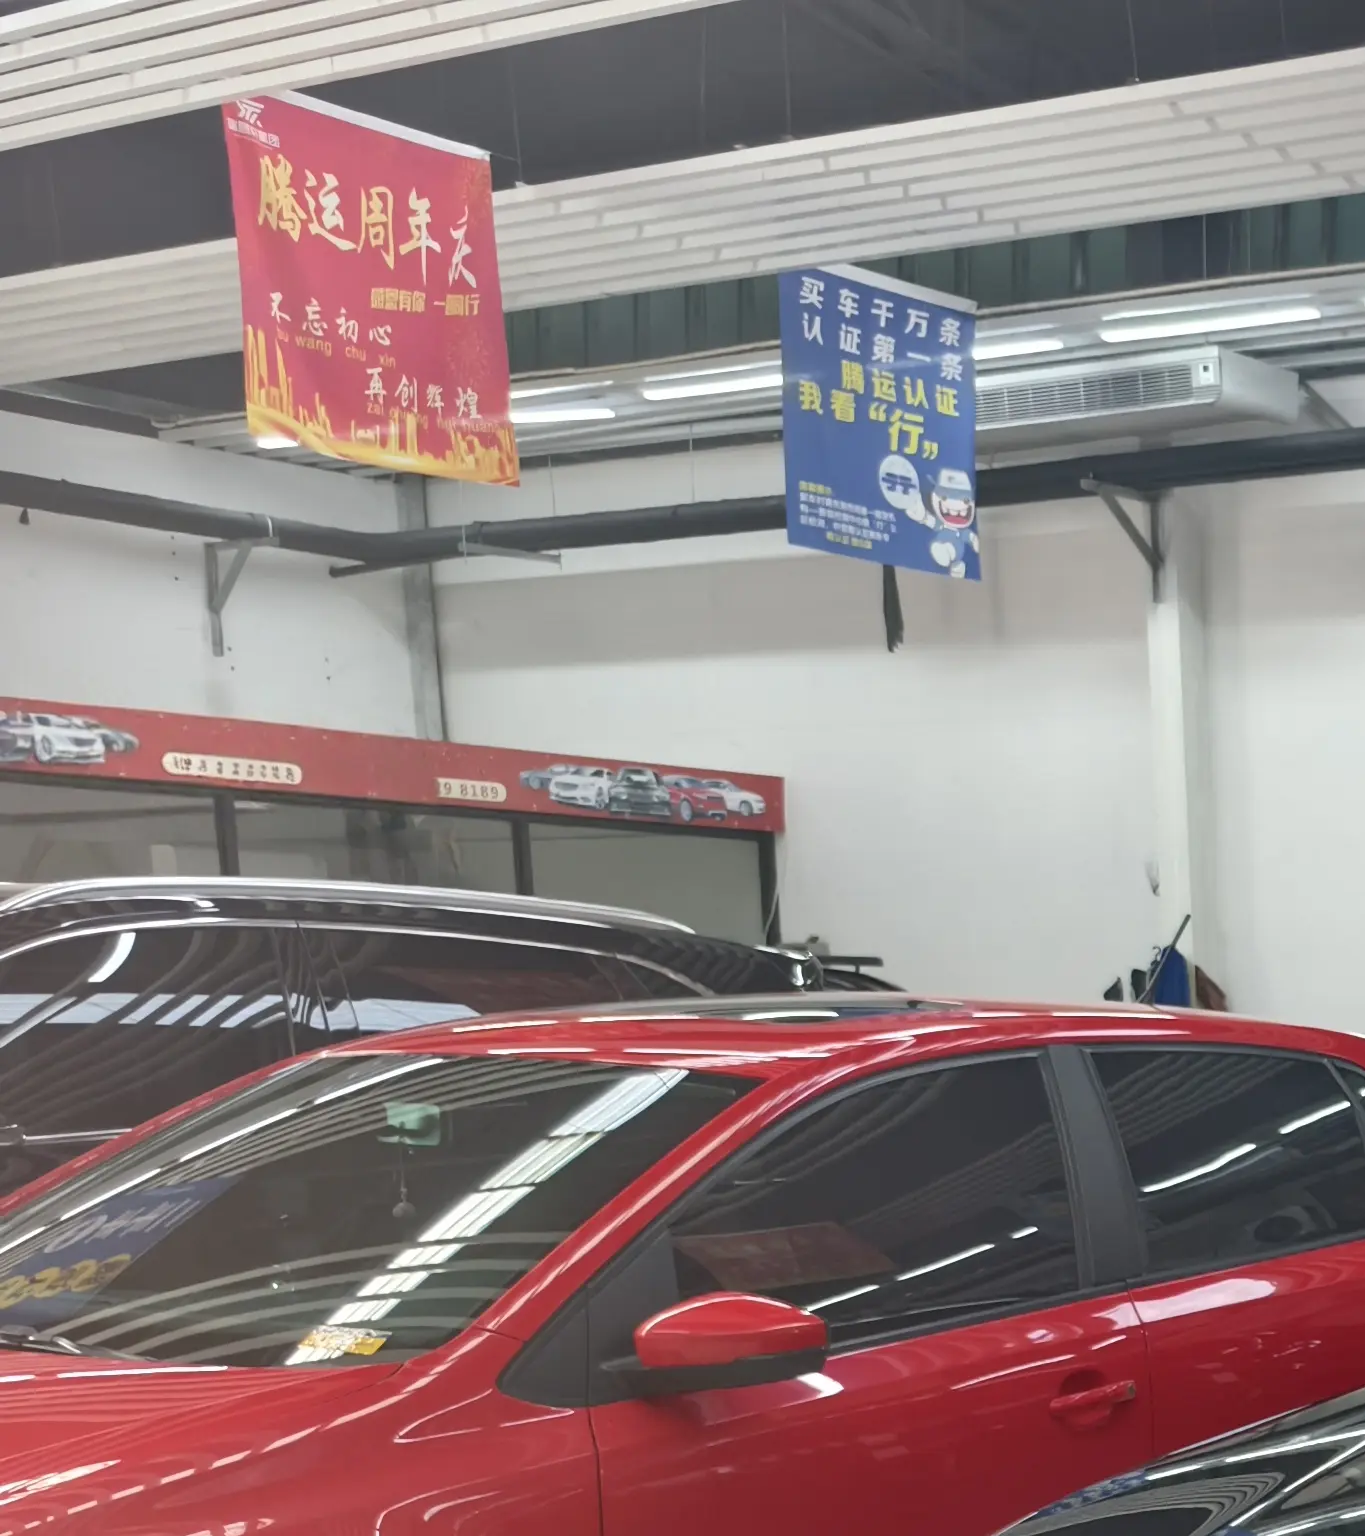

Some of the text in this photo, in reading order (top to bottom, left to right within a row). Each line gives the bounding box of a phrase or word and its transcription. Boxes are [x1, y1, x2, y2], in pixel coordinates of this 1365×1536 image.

[257, 153, 477, 289] 腾运周年庆
[270, 291, 392, 346] 不忘初心
[364, 367, 483, 420] 再创辉煌
